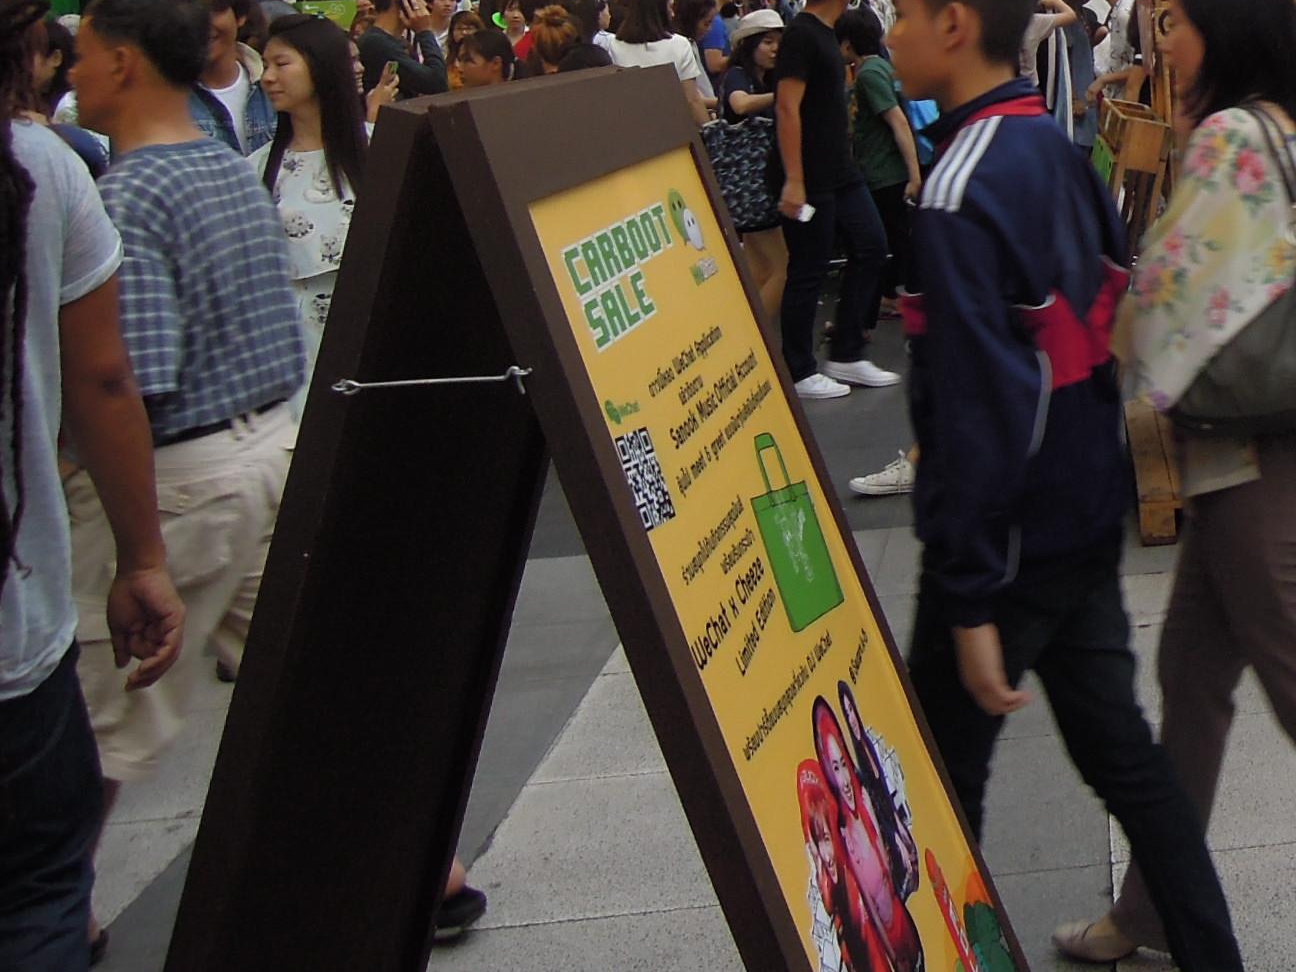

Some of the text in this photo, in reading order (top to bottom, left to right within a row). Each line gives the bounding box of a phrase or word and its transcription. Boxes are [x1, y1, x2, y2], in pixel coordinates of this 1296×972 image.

[564, 203, 672, 296] CARBOOT
[584, 271, 656, 349] SALE
[694, 326, 722, 359] Application
[669, 410, 700, 449] Sanook
[696, 391, 718, 423] Music
[714, 369, 738, 403] Official
[735, 348, 757, 382] Account
[691, 451, 707, 480] meet
[711, 429, 726, 461] greet
[691, 602, 731, 670] WeChat
[736, 556, 764, 605] Cheeze
[736, 588, 775, 676] Limited Edition
[814, 629, 832, 662] WeChat
